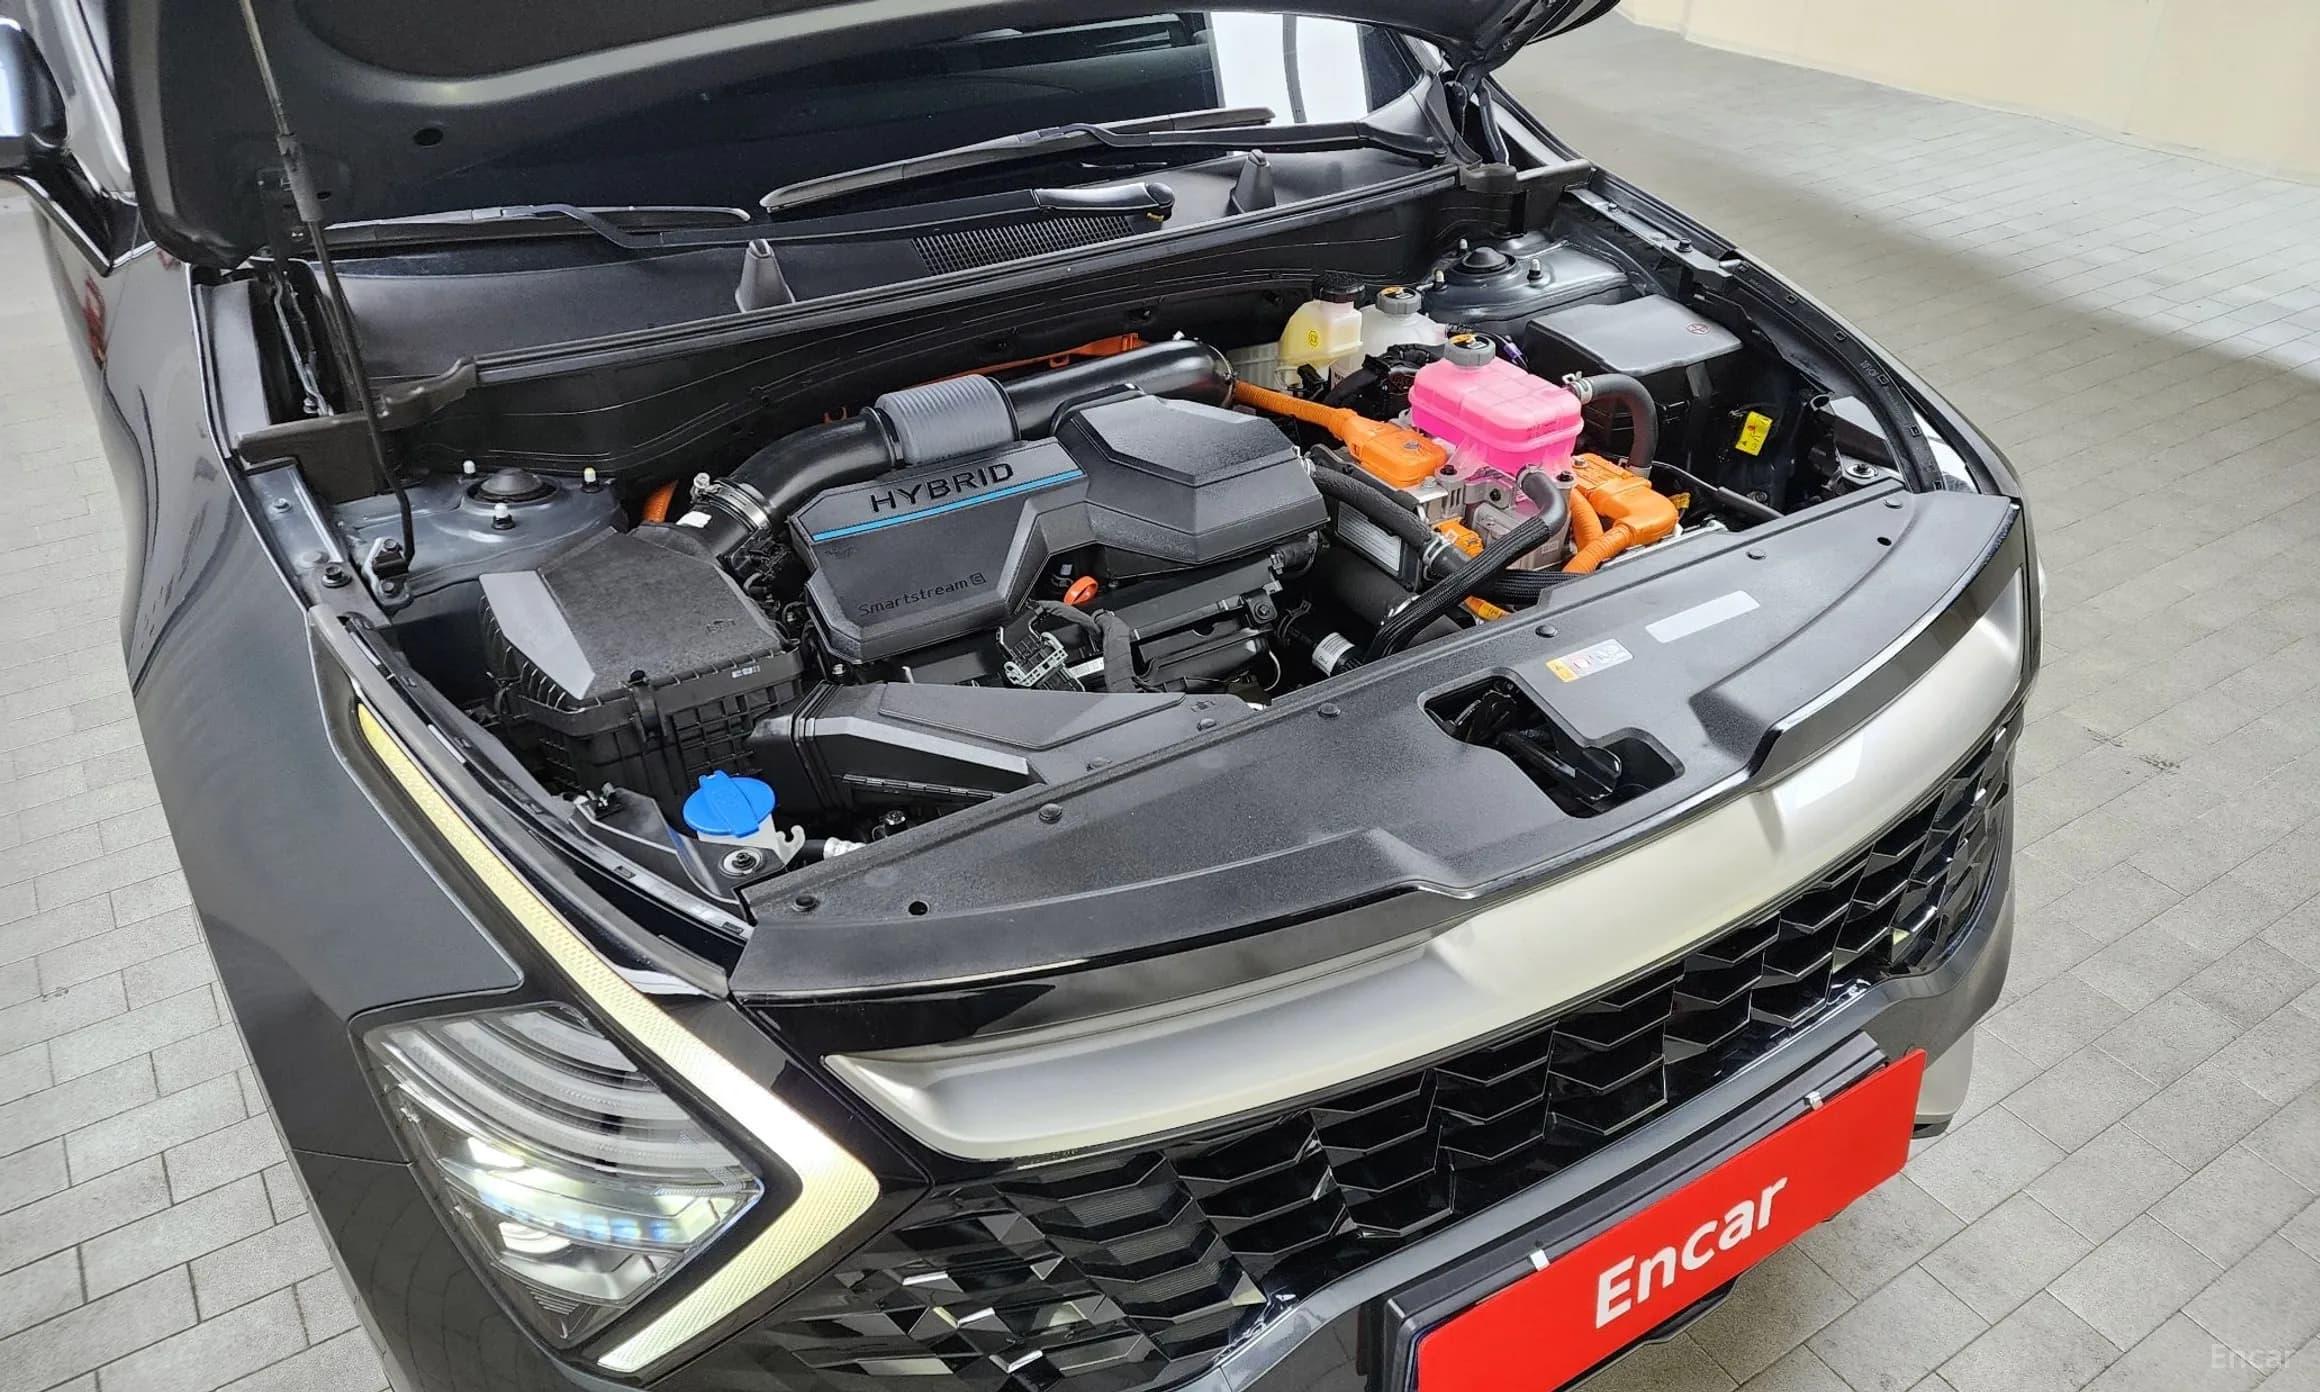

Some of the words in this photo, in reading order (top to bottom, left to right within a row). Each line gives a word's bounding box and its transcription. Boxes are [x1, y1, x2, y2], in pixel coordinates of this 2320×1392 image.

[869, 462, 1014, 513] HYBRID
[857, 578, 969, 617] Smartstream
[1595, 1176, 1788, 1329] Encar
